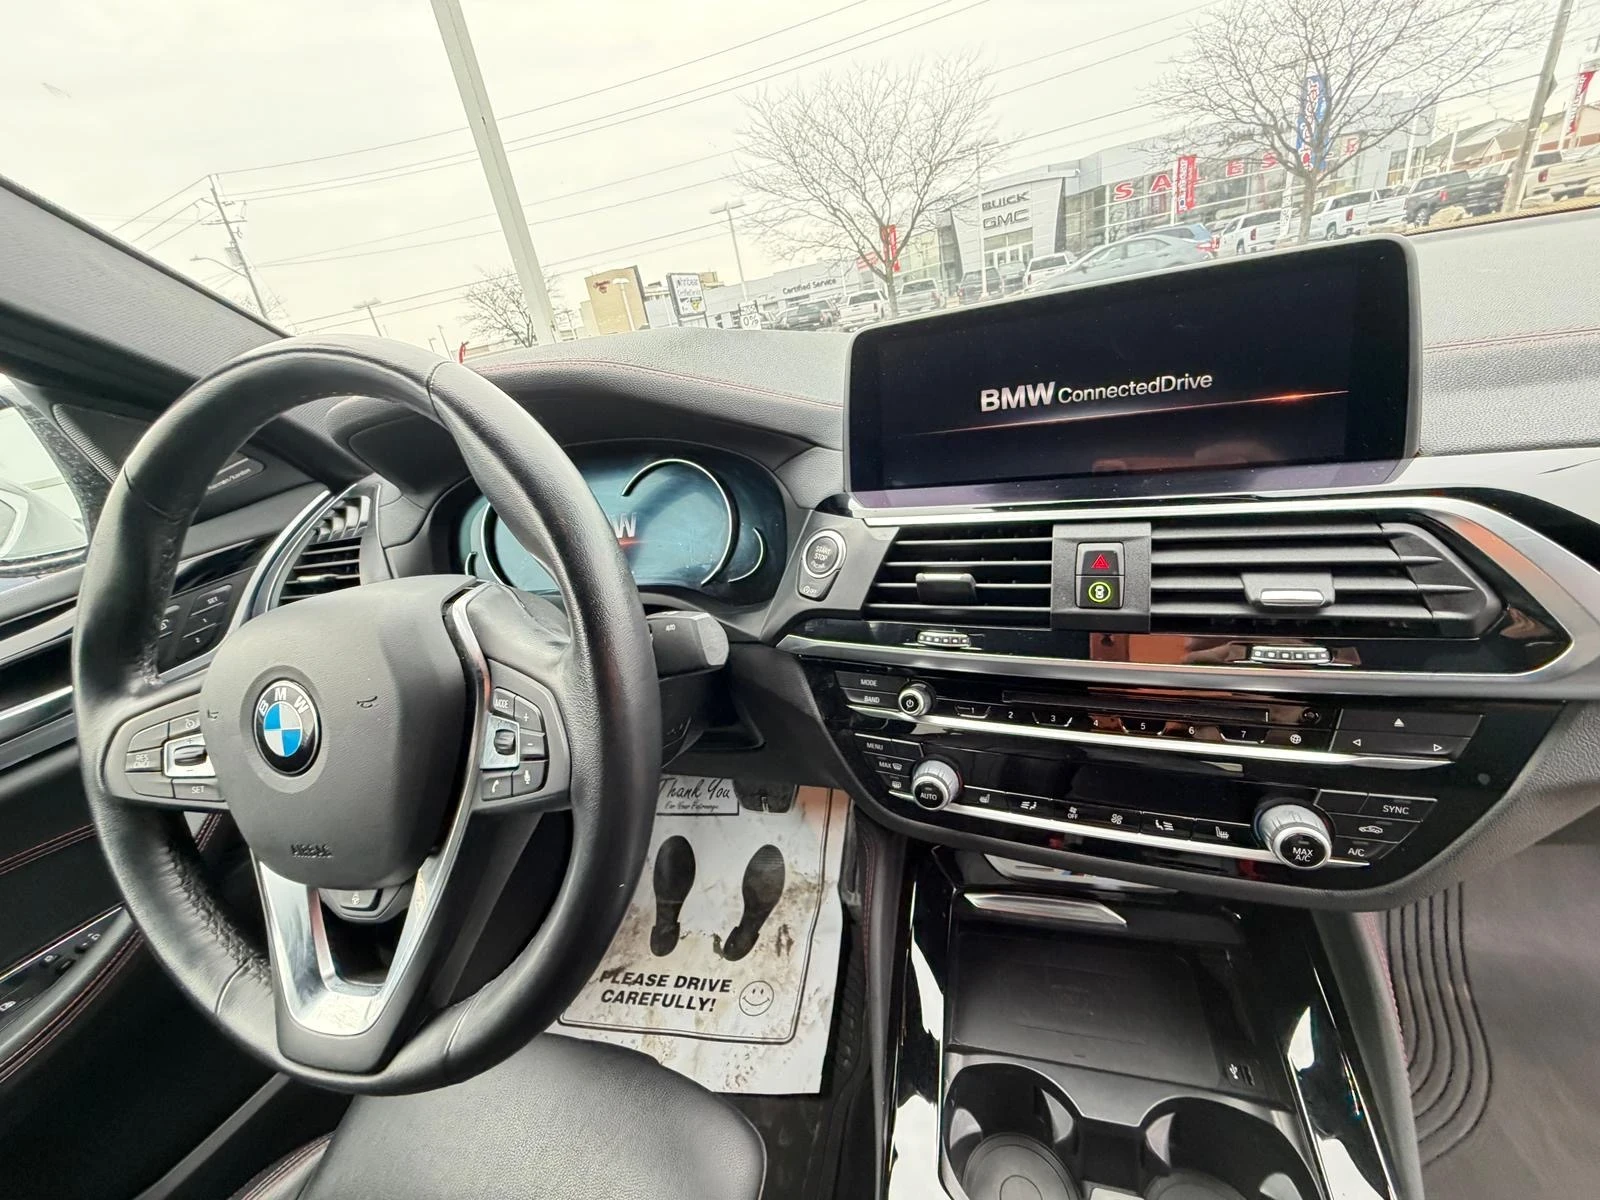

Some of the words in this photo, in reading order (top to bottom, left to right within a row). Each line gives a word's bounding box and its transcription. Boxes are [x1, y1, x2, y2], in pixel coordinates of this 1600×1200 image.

[981, 190, 1030, 211] BUICK
[982, 208, 1030, 230] GMC
[782, 282, 811, 295] Certified
[812, 278, 837, 289] Service
[979, 381, 1055, 413] BMW
[1058, 371, 1213, 404] ConnectedDrive
[815, 545, 831, 555] START
[813, 552, 828, 561] STOP
[860, 679, 878, 687] MODE
[258, 687, 310, 717] BMW
[864, 695, 880, 704] BAND
[1008, 711, 1014, 719] 2
[1093, 719, 1099, 727] 4
[1140, 722, 1146, 730] 5
[1188, 727, 1195, 735] 6
[1241, 730, 1247, 738] 7
[866, 742, 884, 751] MENU
[879, 761, 892, 769] MAX
[191, 785, 205, 794] SET
[659, 777, 705, 799] Thank
[707, 777, 731, 800] You
[920, 792, 938, 801] AUTO
[1382, 804, 1410, 815] SYNC
[1292, 846, 1314, 857] MAX
[1347, 847, 1365, 857] A/C
[1294, 854, 1311, 863] A/C
[599, 969, 670, 988] PLEASE
[673, 974, 733, 993] DRIVE
[600, 989, 717, 1013] CAREFULLY!
